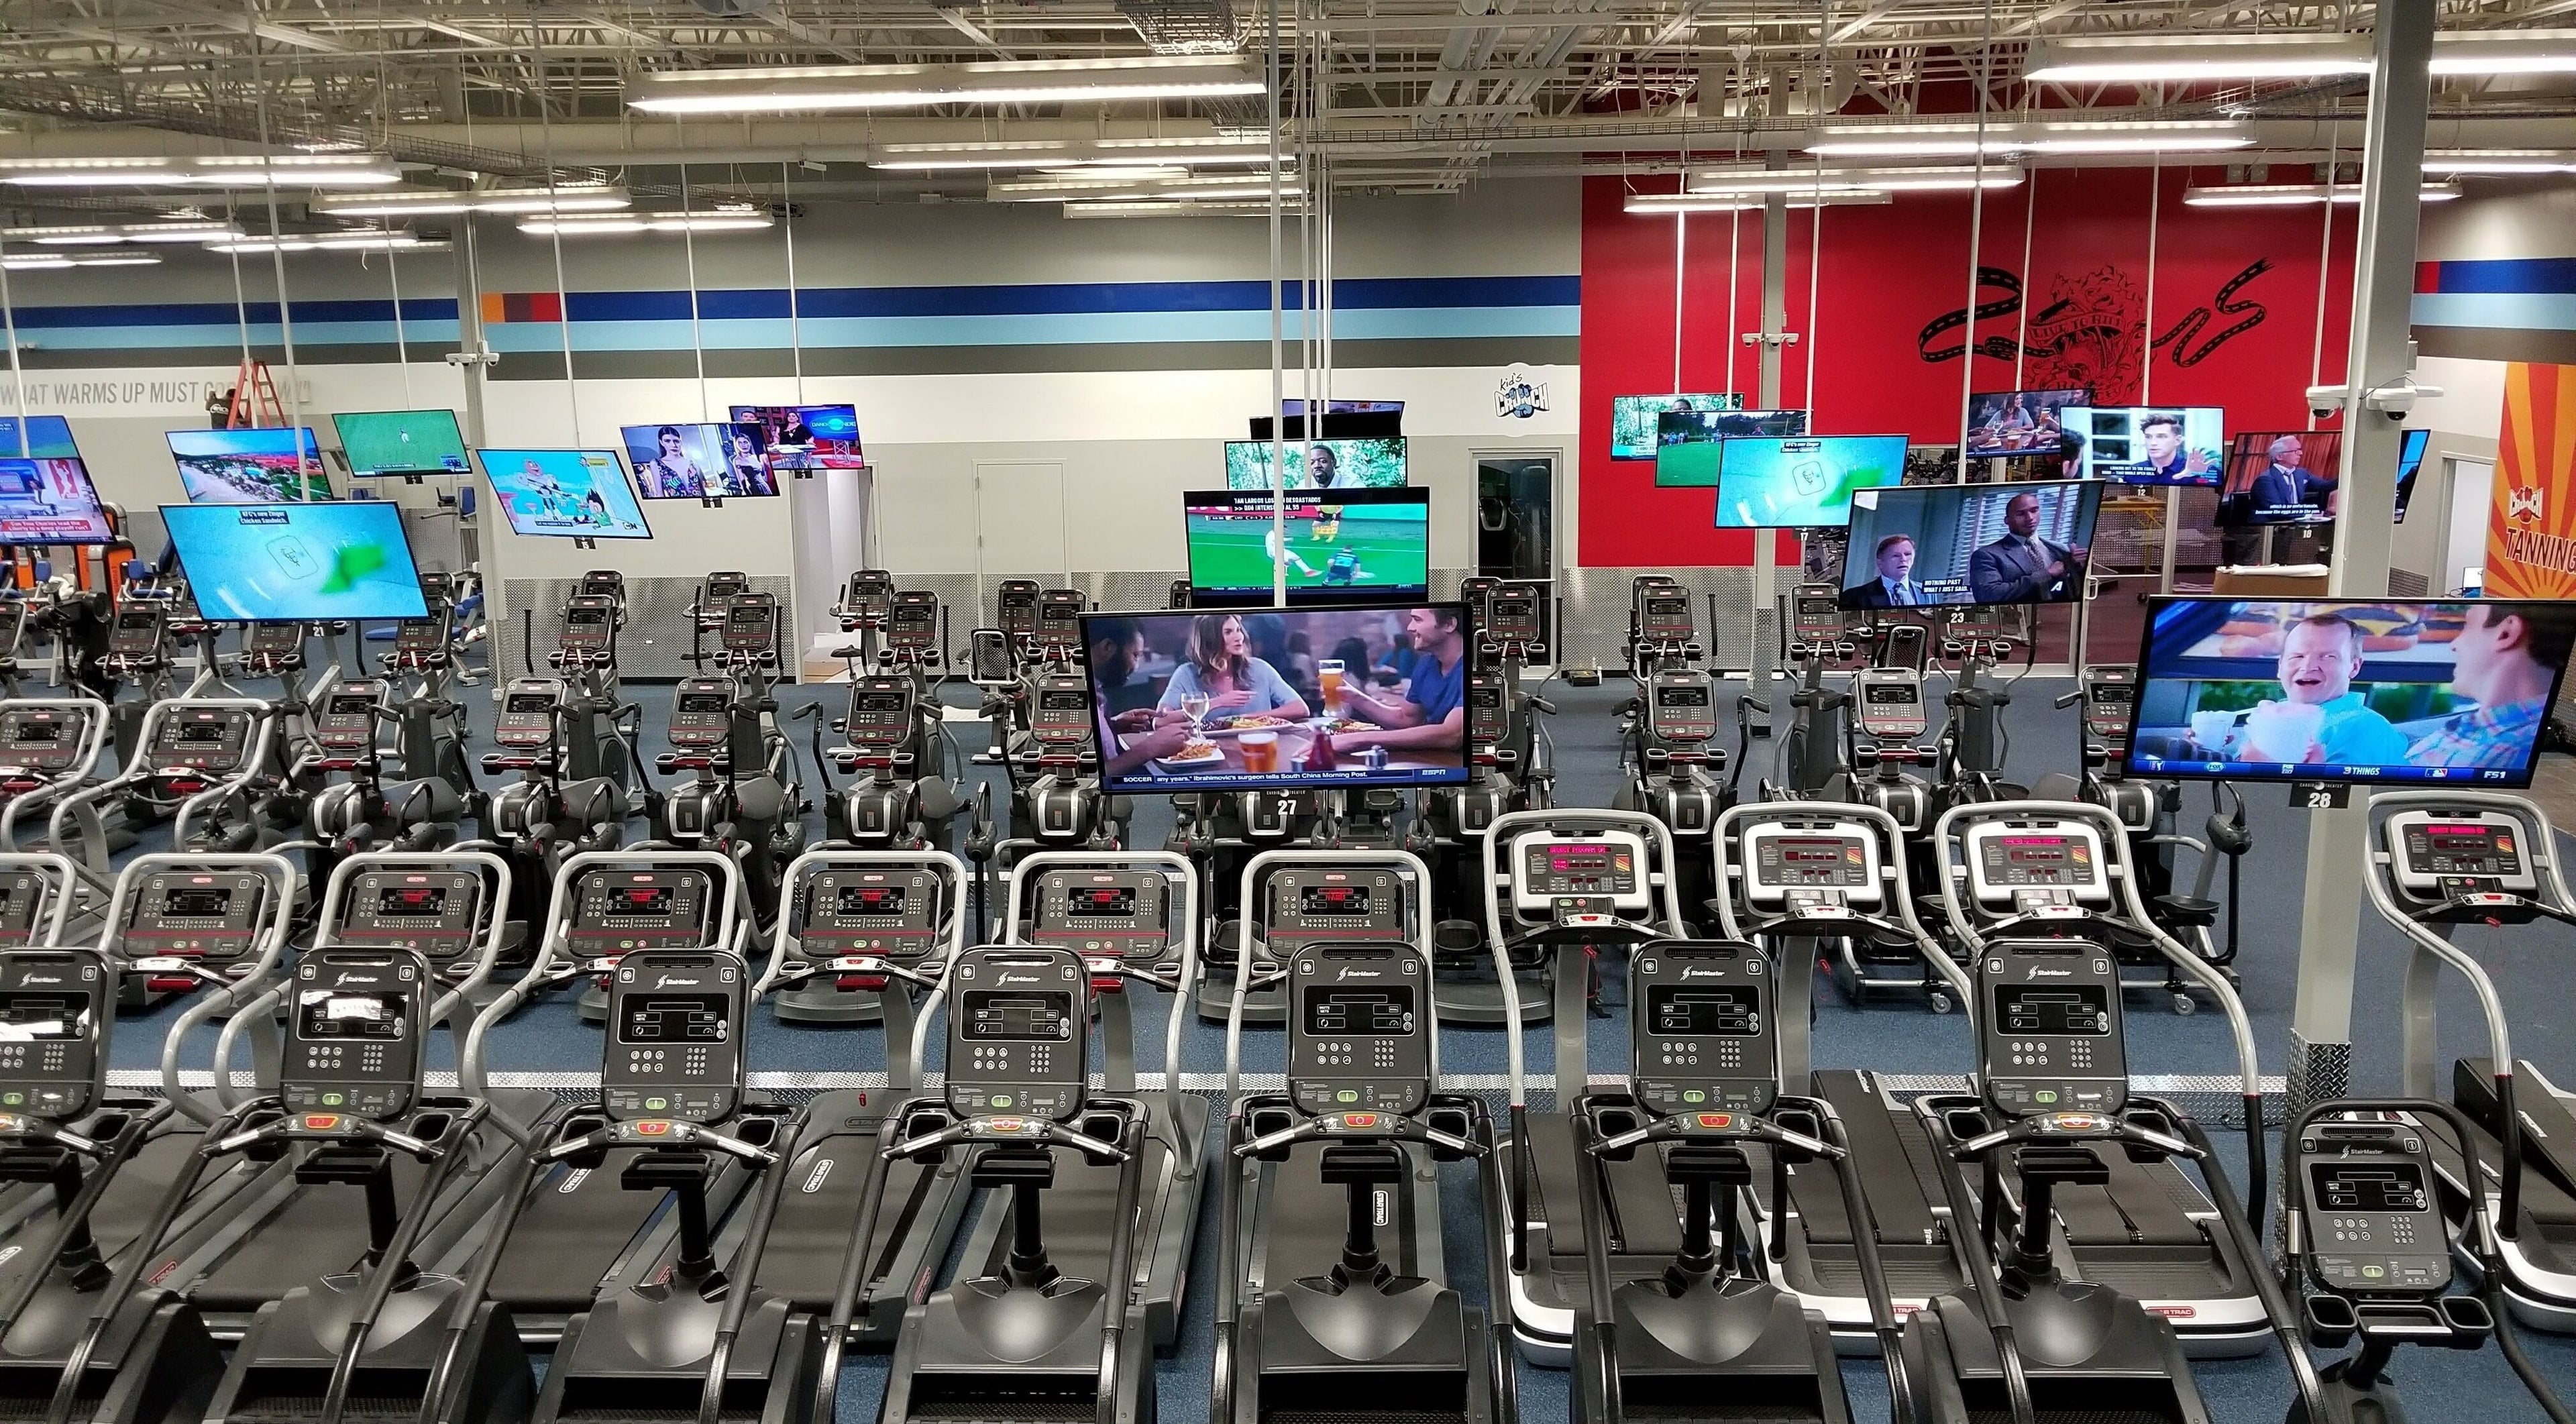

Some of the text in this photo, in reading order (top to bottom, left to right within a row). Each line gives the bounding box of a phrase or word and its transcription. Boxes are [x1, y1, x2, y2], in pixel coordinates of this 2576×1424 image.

[1500, 372, 1523, 391] kid's
[54, 382, 117, 404] WARMS
[123, 382, 146, 404] UP
[150, 381, 199, 403] MUST
[1494, 382, 1550, 417] CRUNCH
[2137, 488, 2146, 496] 12
[1800, 532, 1809, 541] 17
[2303, 529, 2312, 539] 18
[581, 541, 590, 550] 15
[2505, 527, 2576, 575] TANNING
[1950, 612, 1964, 624] 23
[313, 626, 325, 637] 21
[2343, 766, 2380, 776] 3 THINGS
[2483, 771, 2506, 779] FS1
[2308, 792, 2332, 808] 28
[1277, 800, 1297, 815] 27
